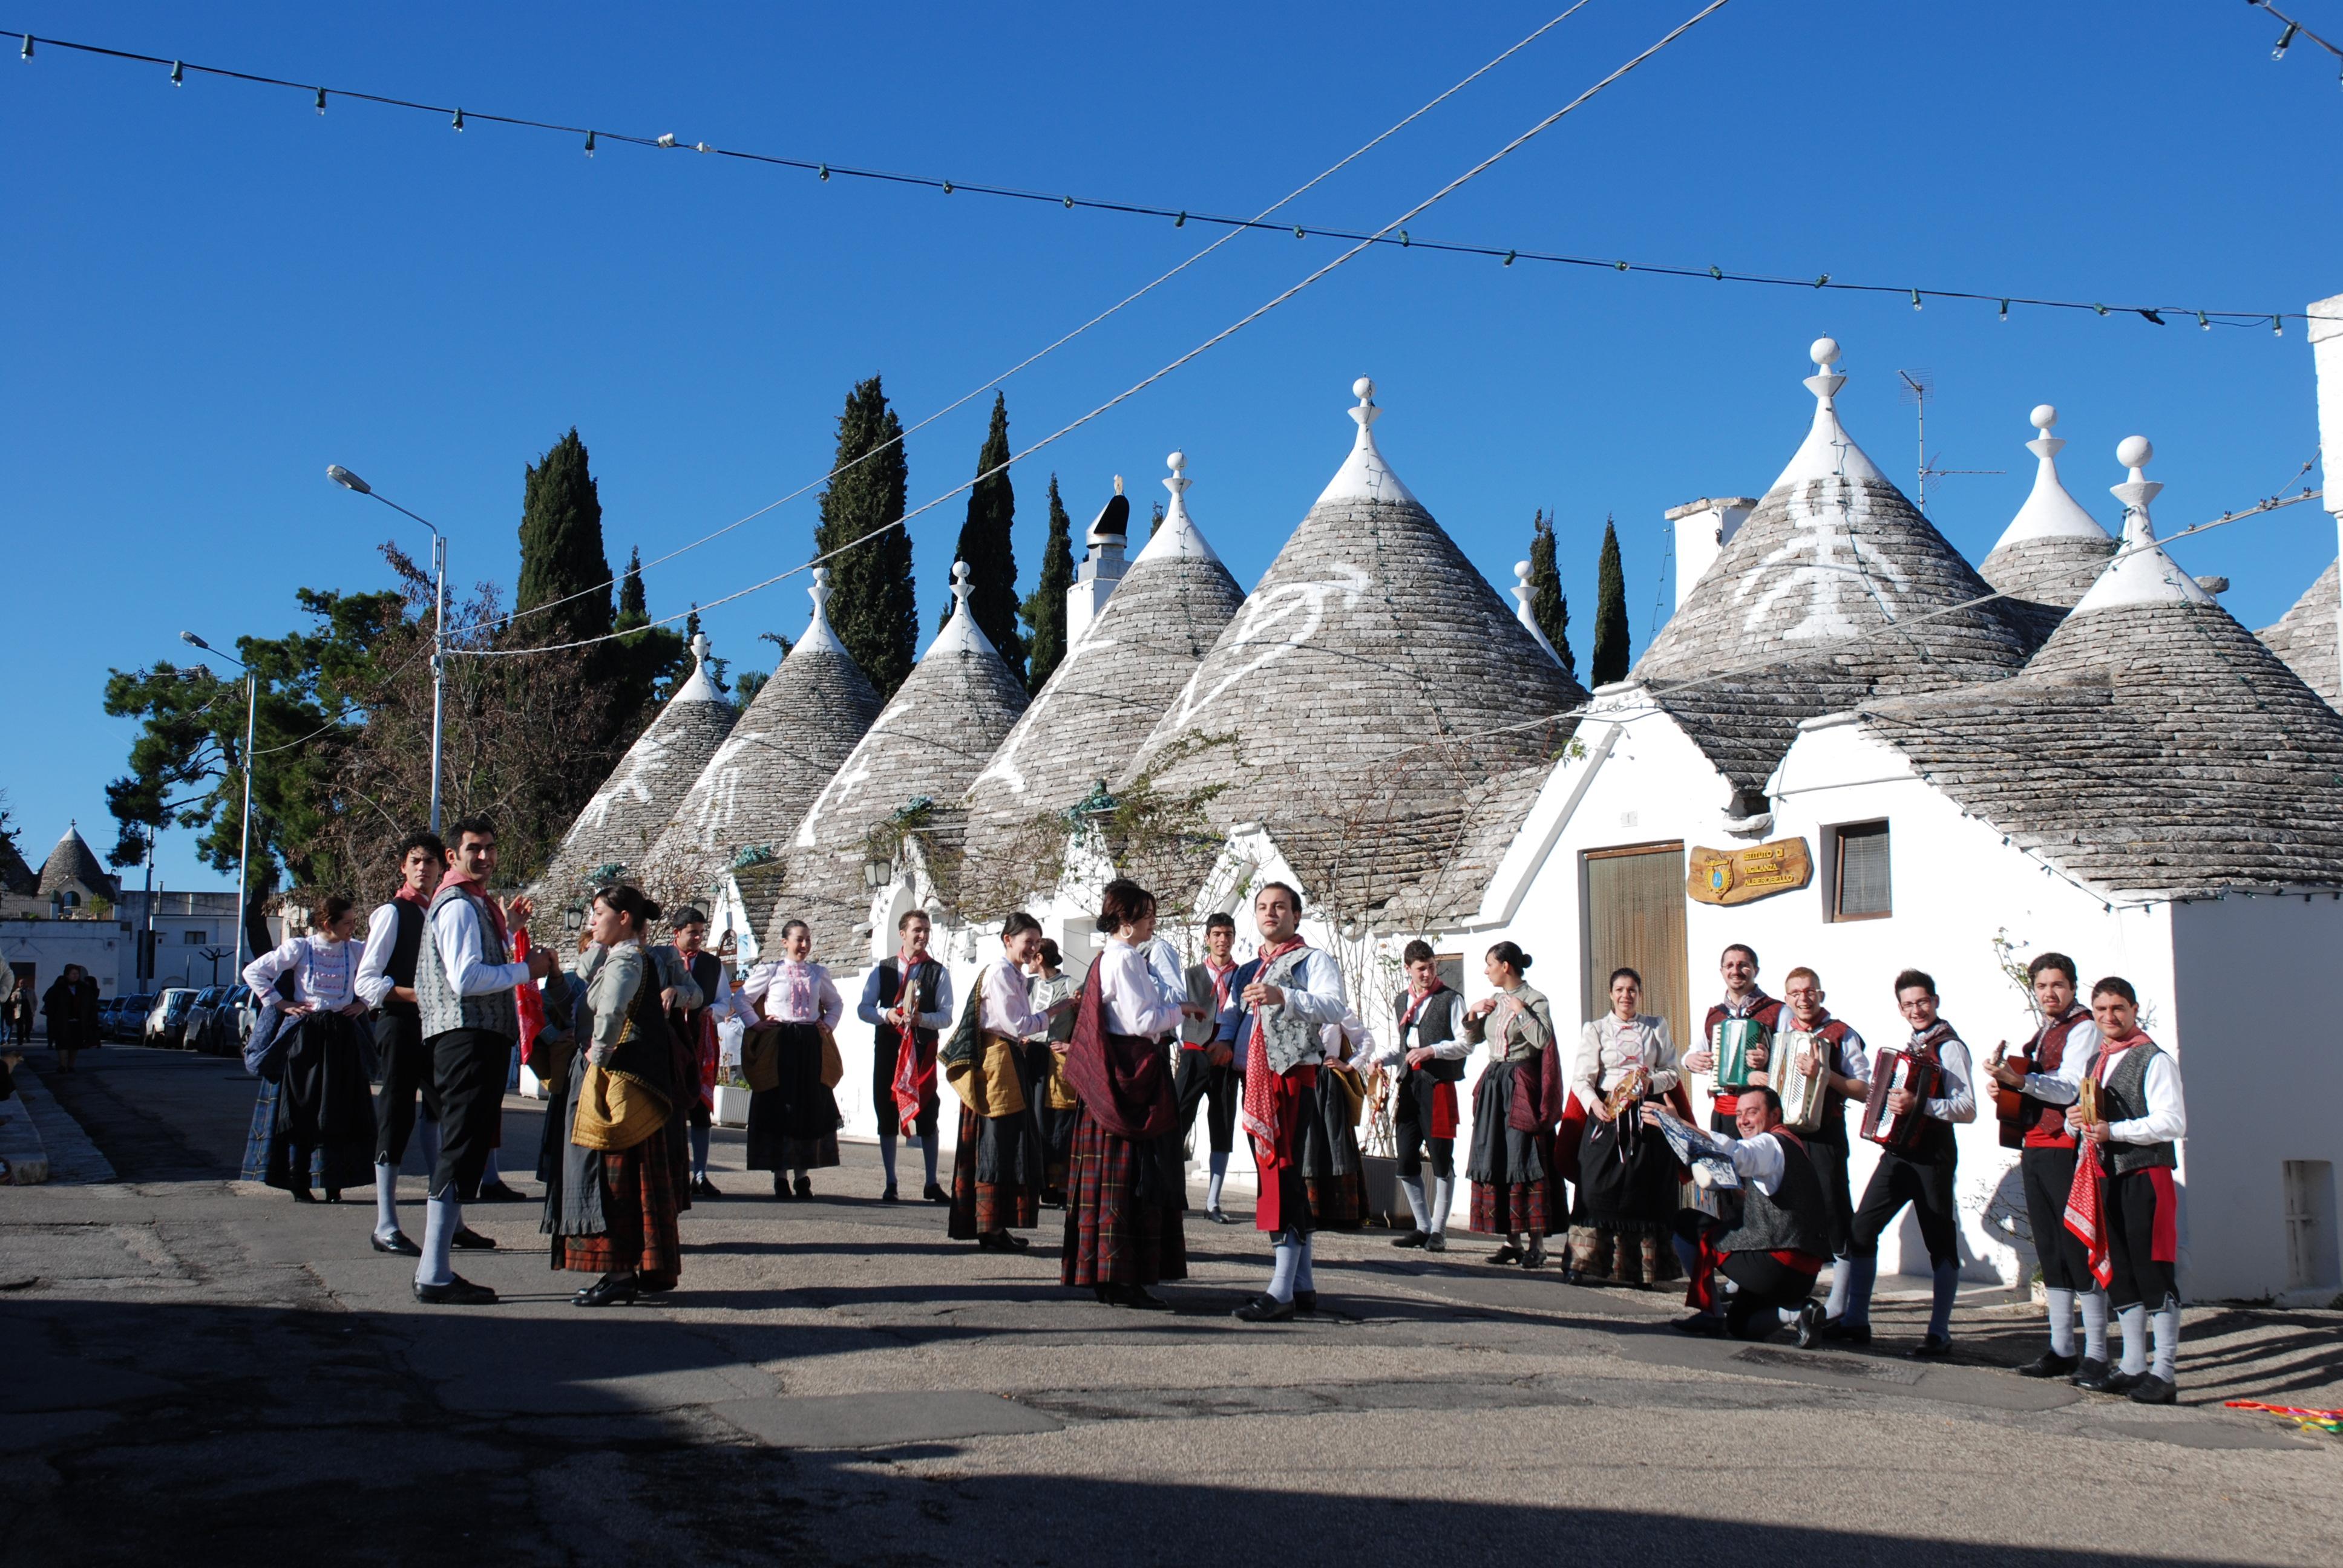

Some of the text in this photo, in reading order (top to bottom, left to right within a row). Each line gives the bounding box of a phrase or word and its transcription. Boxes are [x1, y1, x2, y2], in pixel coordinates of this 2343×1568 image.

[1776, 848, 1784, 857] DI
[1744, 864, 1778, 874] VIGILANZA
[1745, 875, 1794, 886] ALBEROBELLO
